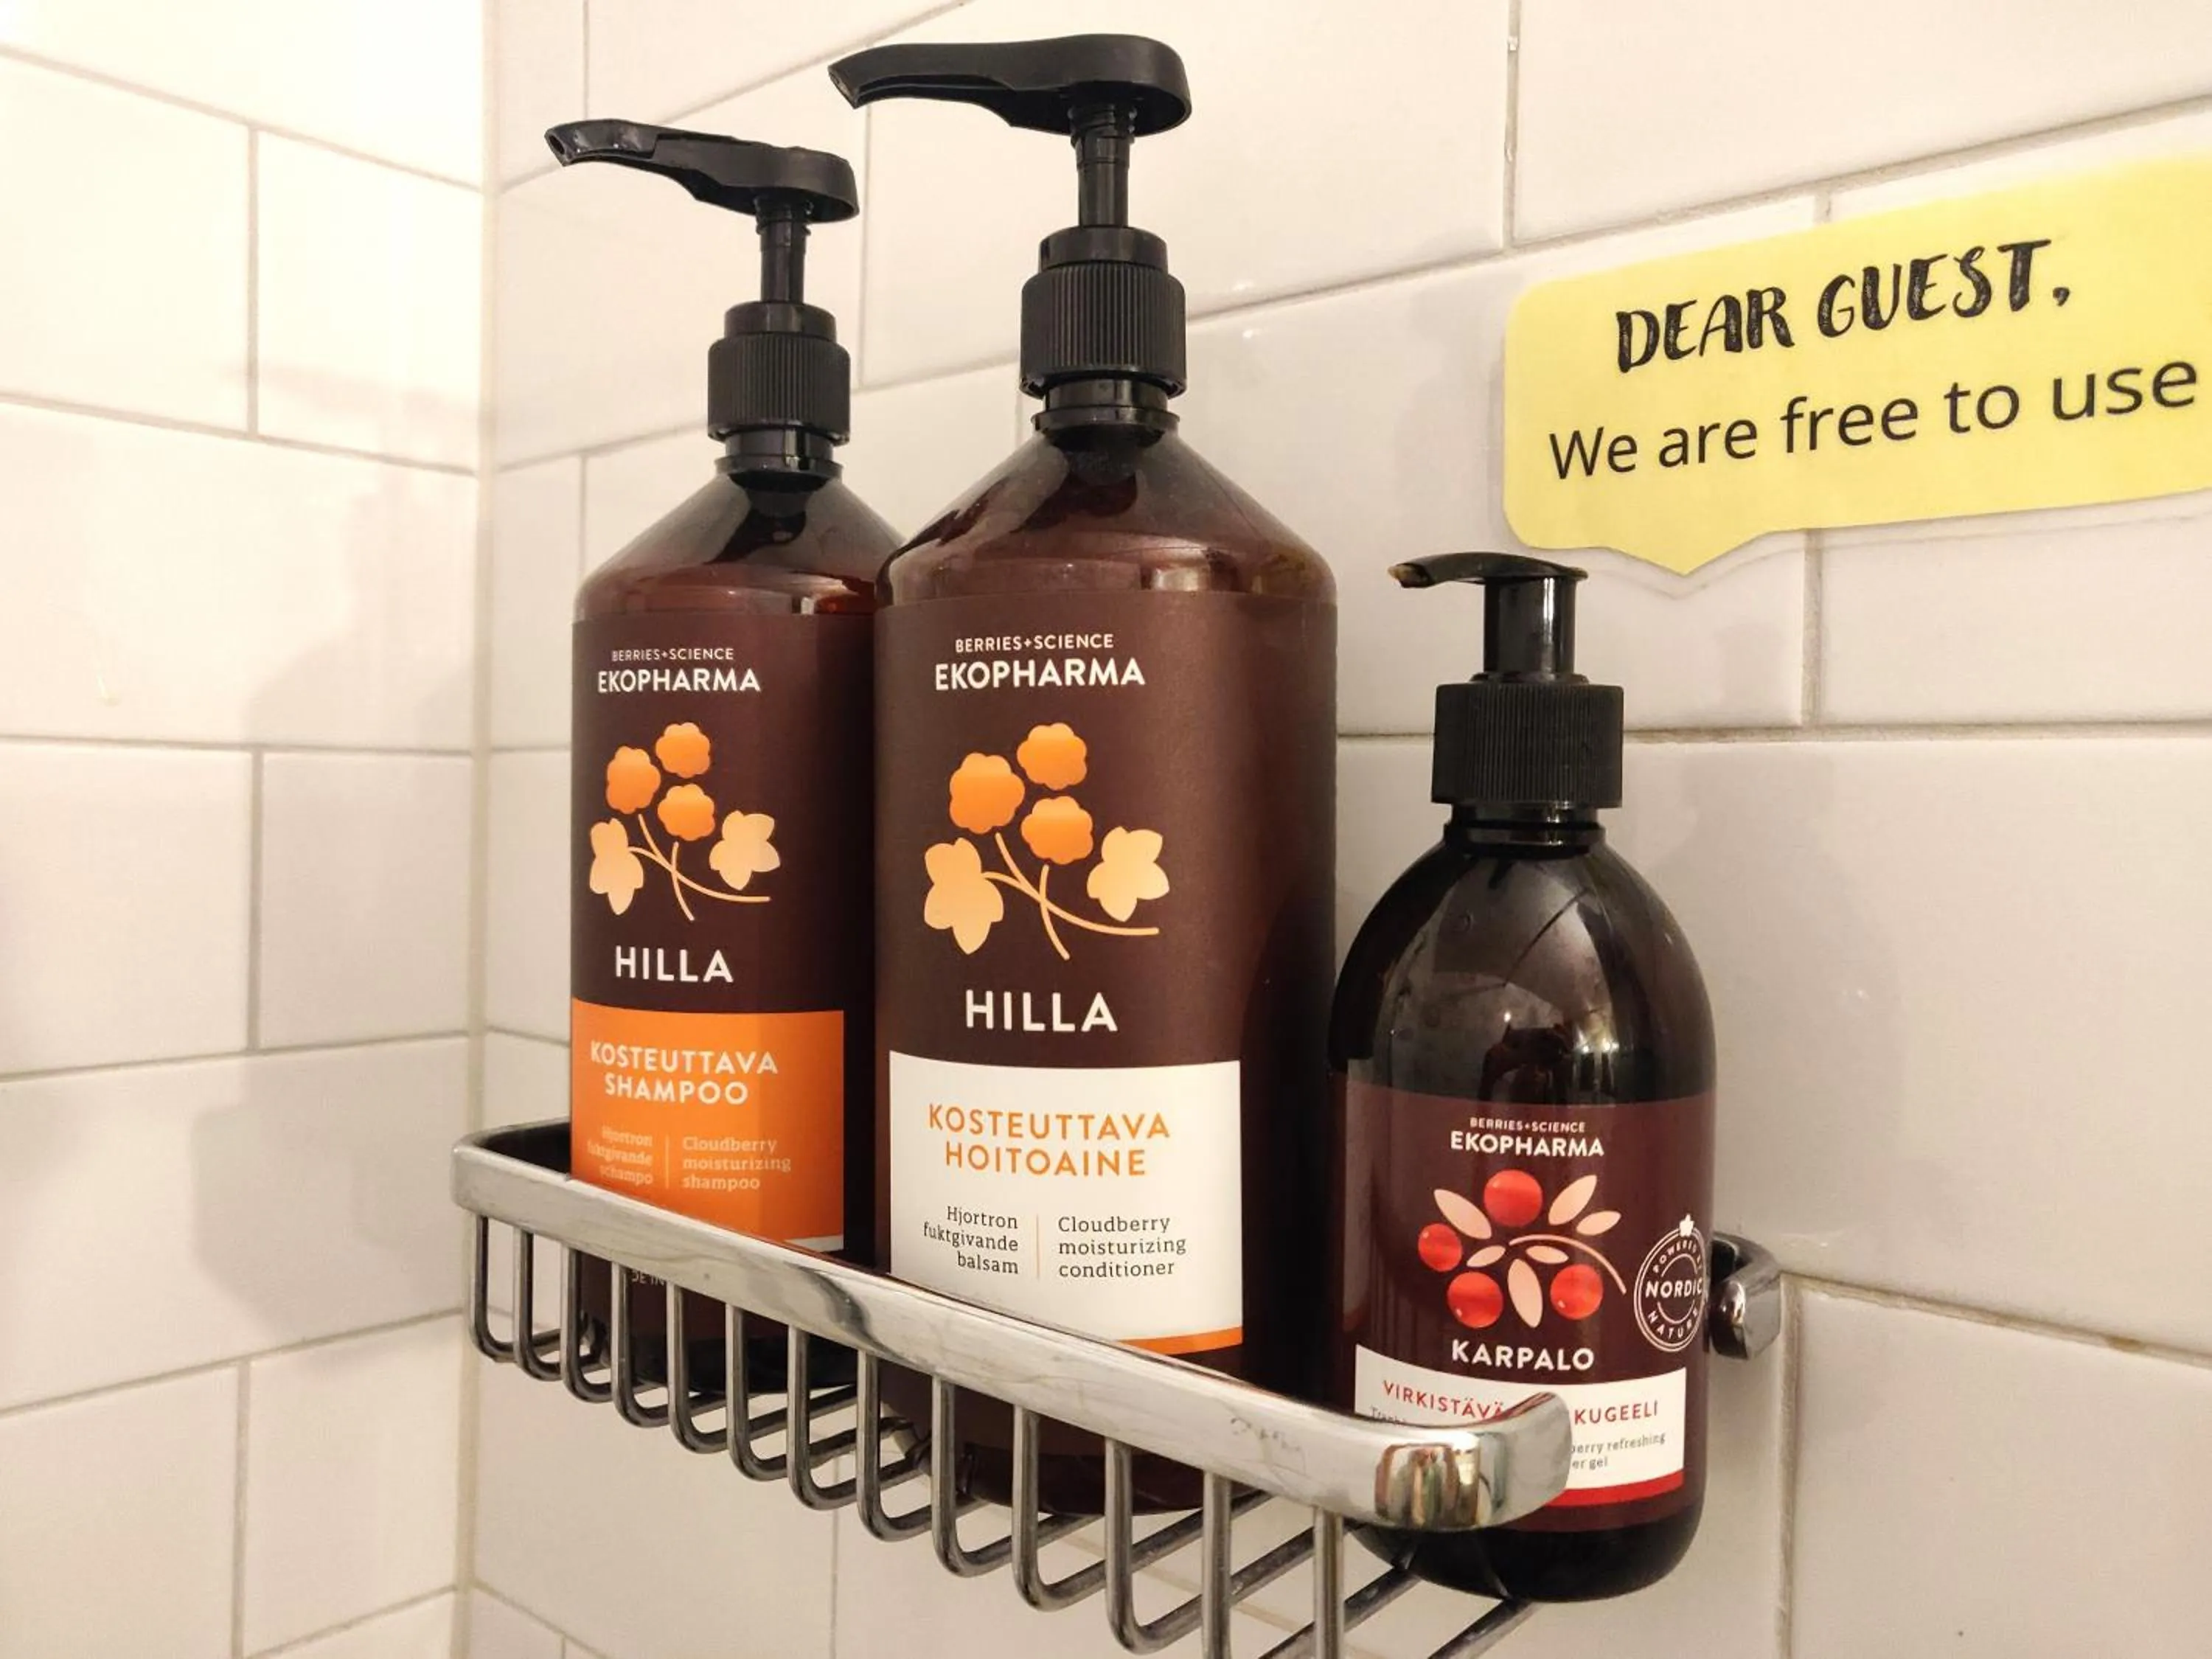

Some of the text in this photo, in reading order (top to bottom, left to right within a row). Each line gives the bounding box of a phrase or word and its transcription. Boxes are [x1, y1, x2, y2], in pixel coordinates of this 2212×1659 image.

[1615, 238, 2072, 373] DEAR GUEST,
[1549, 359, 2198, 480] We are free to use
[955, 633, 1115, 653] BERRIES+SCIENCE
[597, 668, 762, 694] EKOPHARMA
[934, 657, 1146, 692] EKOPHARMA
[615, 945, 734, 984] HILLA
[964, 989, 1119, 1033] HILLA
[591, 1039, 779, 1075] KOSTEUTTAVA
[604, 1073, 749, 1105] SHAMPOO
[928, 1102, 1171, 1141] KOSTEUTTAVA
[682, 1135, 779, 1153] Cloudberry
[1450, 1130, 1605, 1158] EKOPHARMA
[682, 1155, 793, 1173] moisturizing
[945, 1141, 1147, 1177] HOITOAINE
[682, 1173, 762, 1192] shampoo
[946, 1205, 1019, 1230] Hjortron
[1057, 1215, 1172, 1234] Cloudberry
[922, 1222, 1020, 1253] fuktgivande
[1058, 1238, 1188, 1256] moisturizing
[956, 1251, 1020, 1275] balsam
[1058, 1262, 1176, 1279] conditioner
[1644, 1276, 1704, 1299] NORDIC
[1450, 1338, 1596, 1371] KARPALO
[1607, 1432, 1666, 1450] refreshing
[1589, 1455, 1608, 1470] gel
